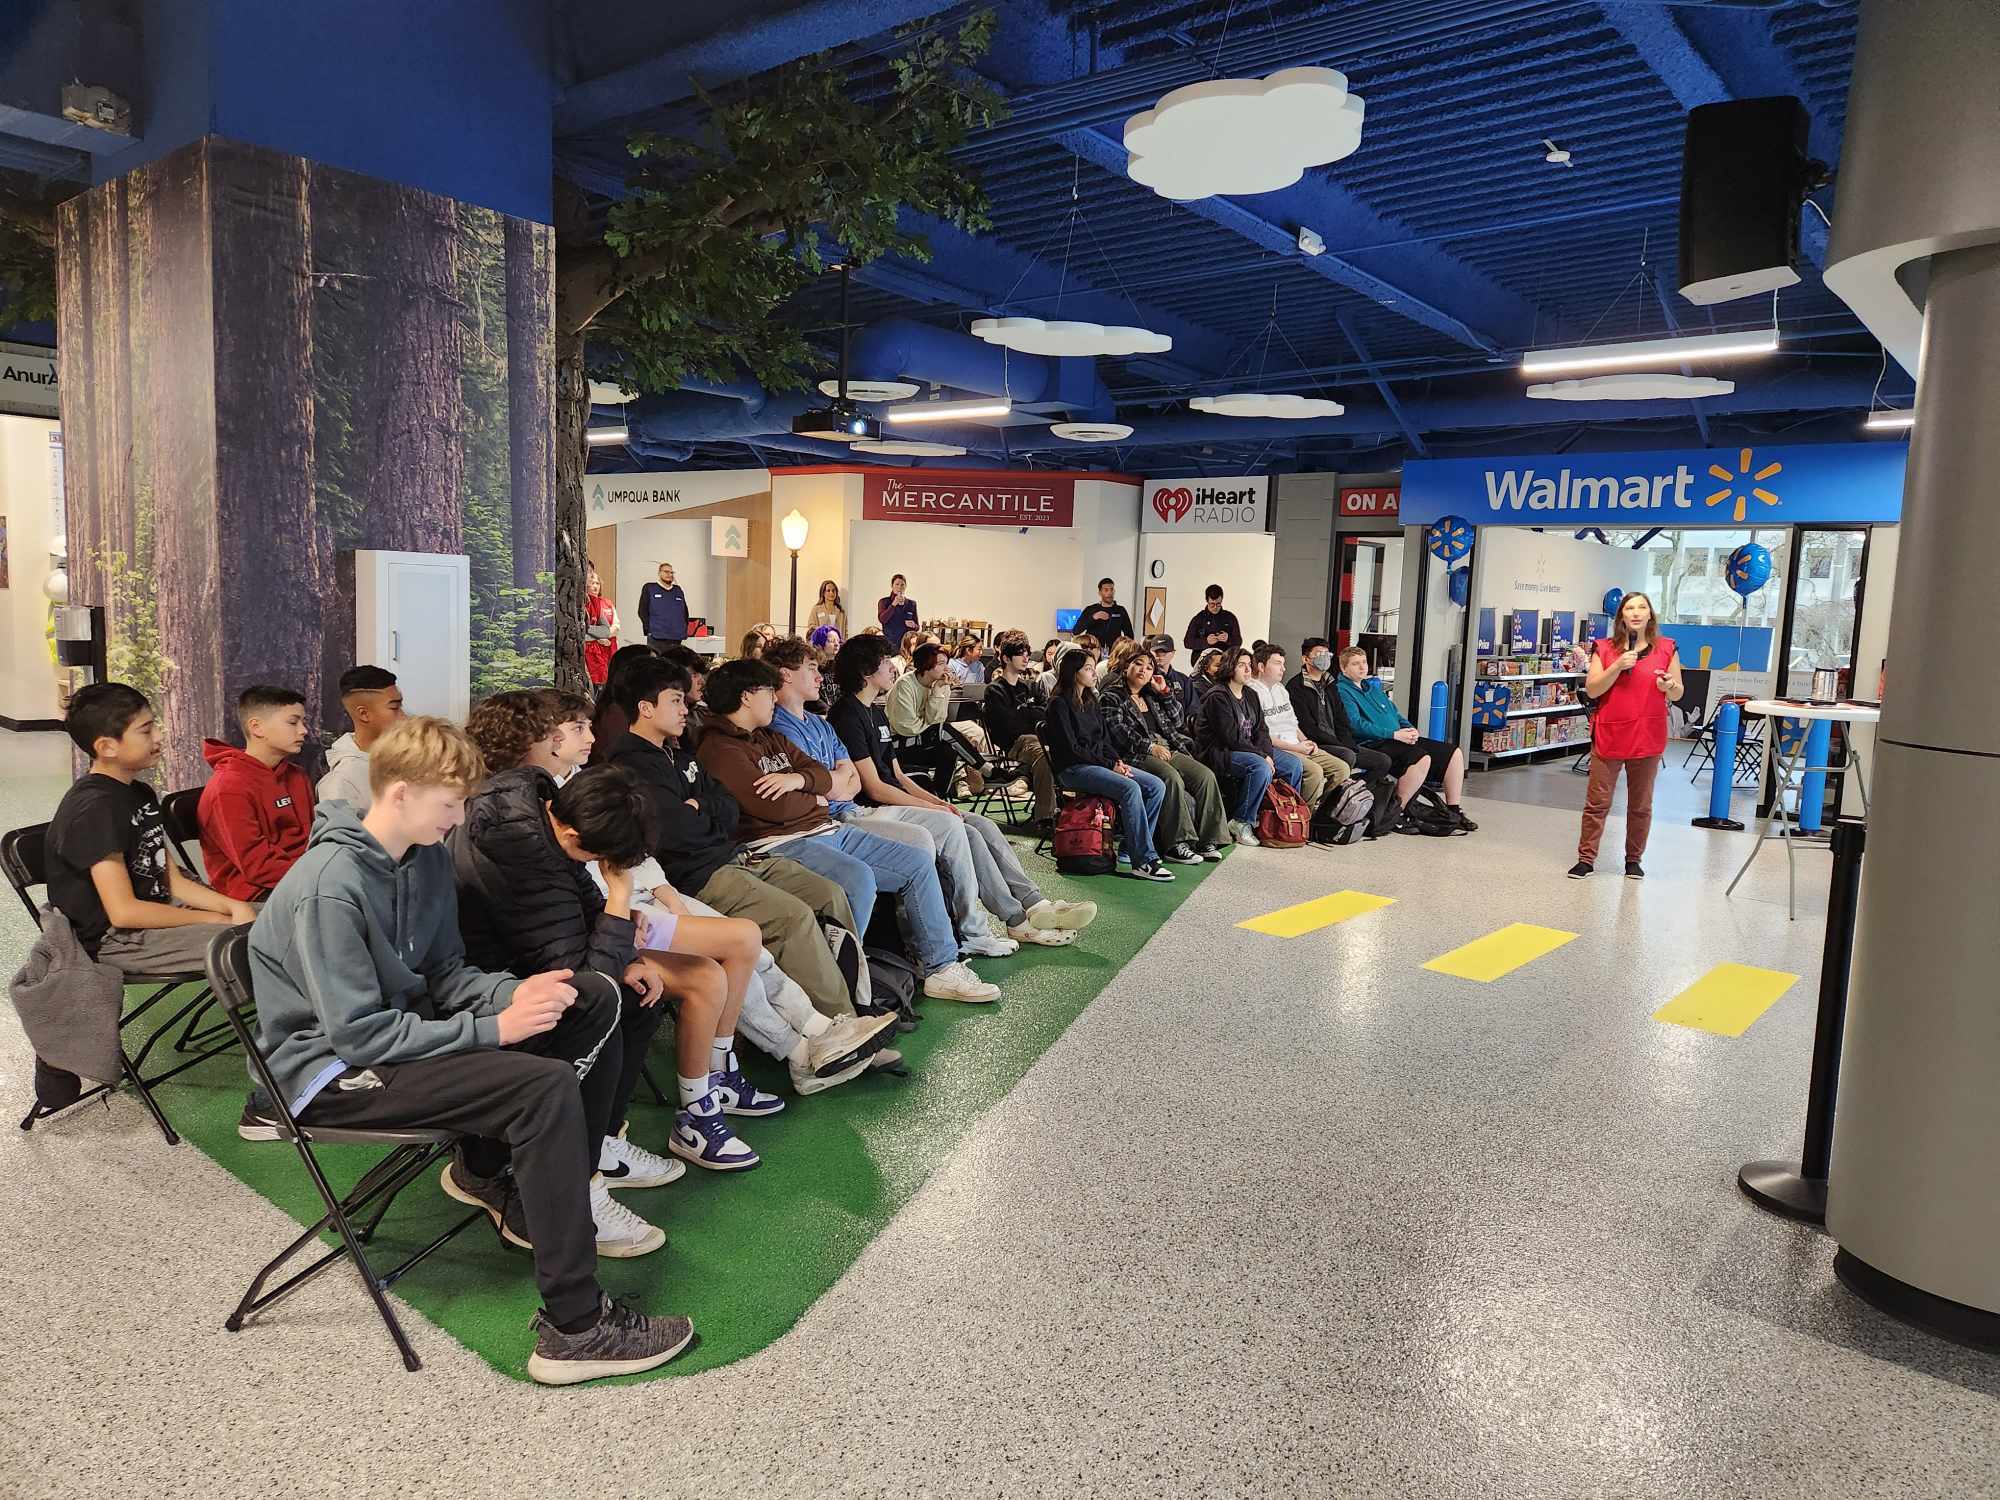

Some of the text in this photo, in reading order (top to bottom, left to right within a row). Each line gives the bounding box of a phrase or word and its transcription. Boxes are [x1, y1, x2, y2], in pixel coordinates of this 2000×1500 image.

[886, 478, 904, 491] The
[1484, 465, 1695, 511] Walmart
[607, 489, 681, 504] UMPQUA BANK
[881, 490, 1055, 513] MERCANTILE
[1195, 487, 1256, 506] iHeart
[1346, 493, 1377, 511] ON
[1193, 506, 1256, 524] RADIO
